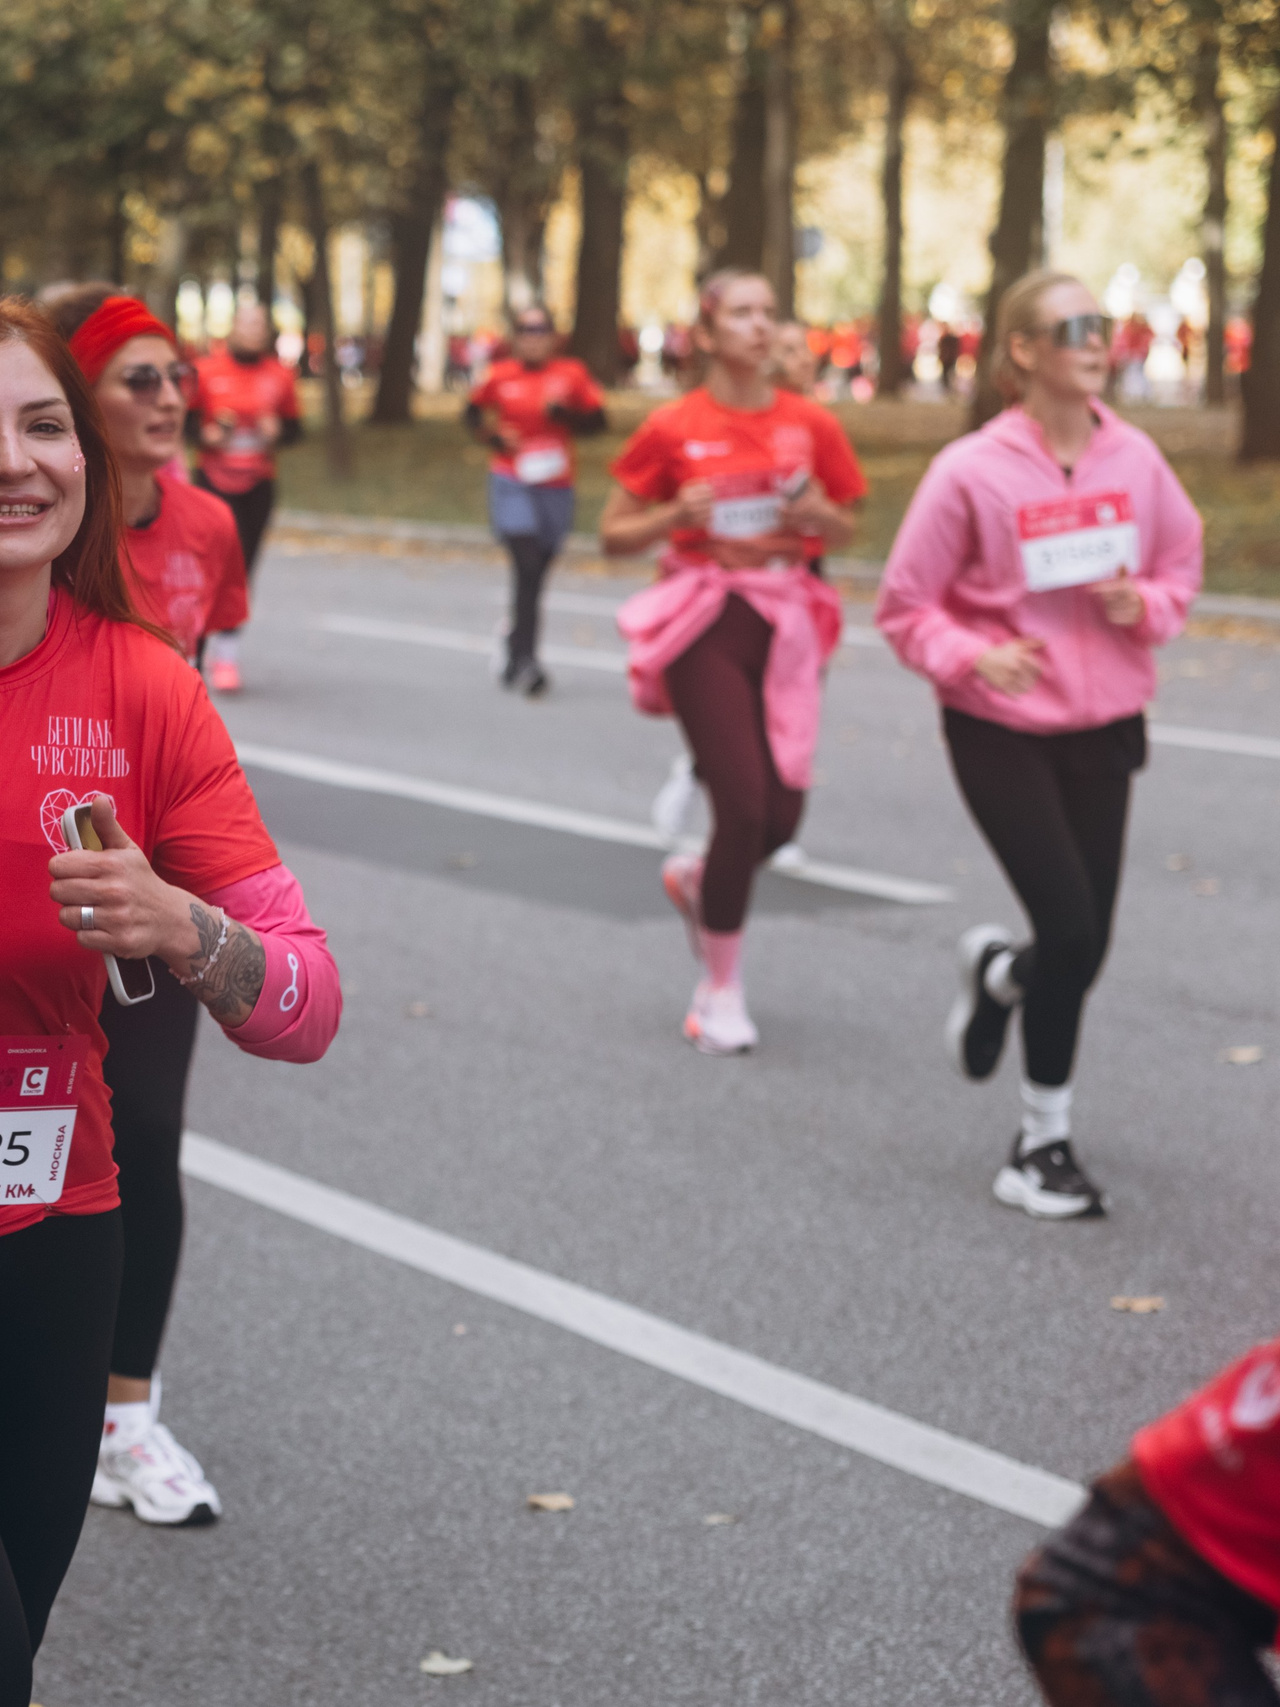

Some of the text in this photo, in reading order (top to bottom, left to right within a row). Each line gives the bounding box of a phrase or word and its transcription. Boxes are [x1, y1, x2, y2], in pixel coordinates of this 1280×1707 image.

[47, 715, 113, 748] БЕГИ КАК
[31, 745, 130, 778] ЧУВСТВУЕШЬ
[49, 1124, 67, 1181] МОСКВА
[5, 1183, 33, 1198] КМ
